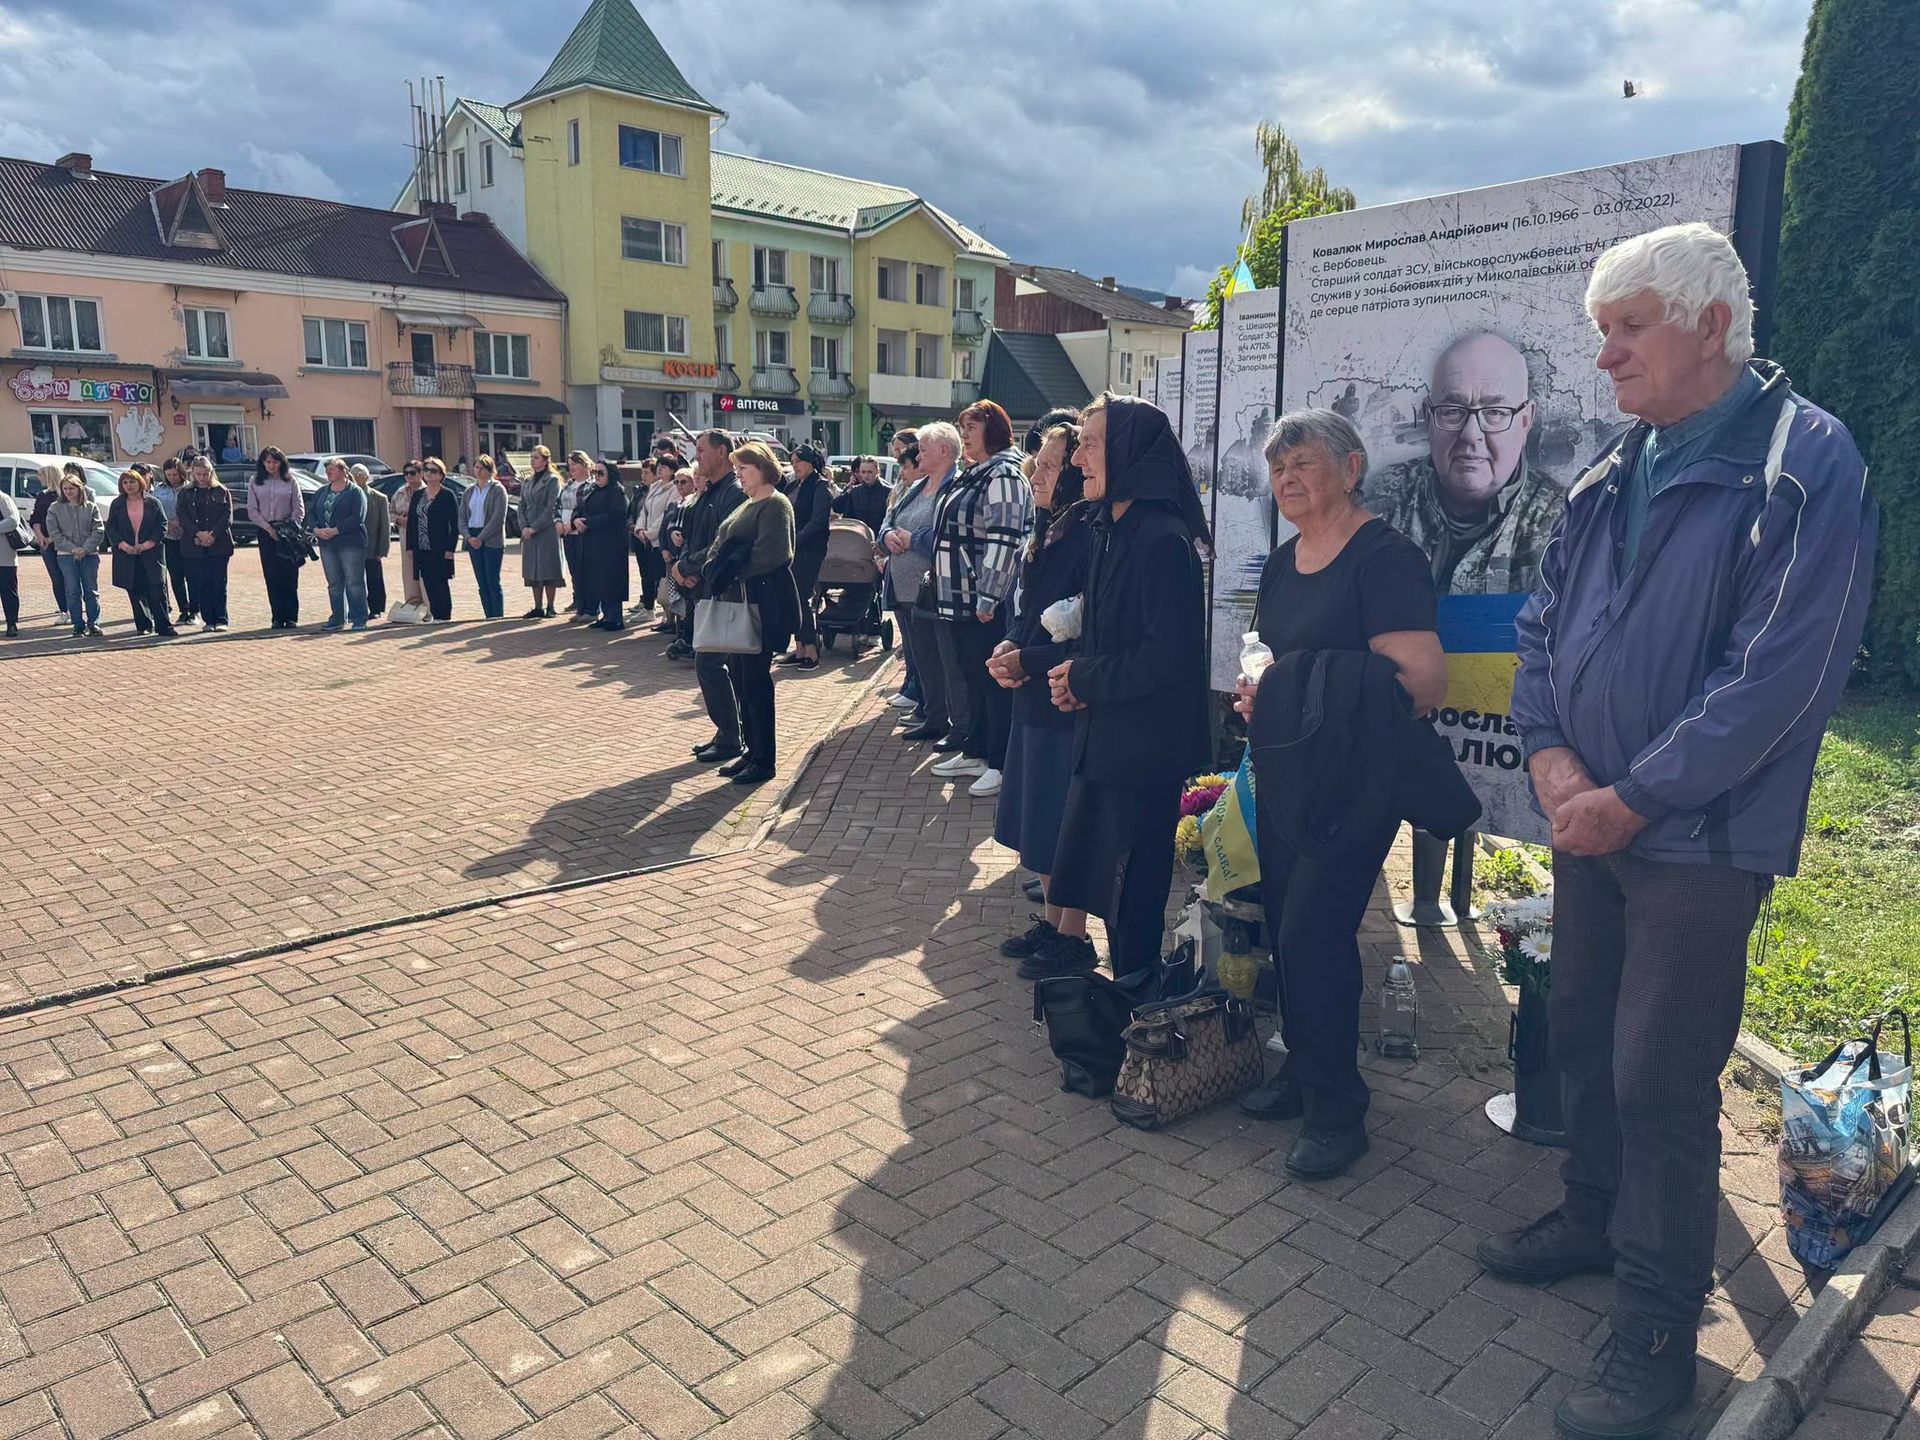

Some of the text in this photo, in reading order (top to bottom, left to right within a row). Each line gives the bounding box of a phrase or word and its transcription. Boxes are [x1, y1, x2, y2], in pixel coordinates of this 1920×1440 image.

[1312, 243, 1362, 258] Ковалюк
[1365, 233, 1426, 251] Мирослав
[1429, 222, 1508, 241] Андрійович
[1512, 208, 1579, 231] (16.10.1966
[1593, 193, 1680, 216] 03.07.2022).
[1311, 272, 1360, 288] Старший
[1364, 267, 1403, 282] солдат
[1406, 262, 1431, 276] ЗСУ,
[1434, 245, 1581, 272] військовослужбовець
[1311, 288, 1351, 303] Служив
[1354, 289, 1361, 299] у
[1364, 283, 1387, 296] зоні
[1390, 278, 1440, 294] бойових
[1444, 274, 1463, 288] дій
[1465, 274, 1473, 286] у
[1477, 260, 1576, 283] Миколаївській
[1312, 257, 1387, 273] с. Вербовець.
[1310, 289, 1490, 319] де серце патріота зупинилося.
[737, 398, 779, 411] аптека
